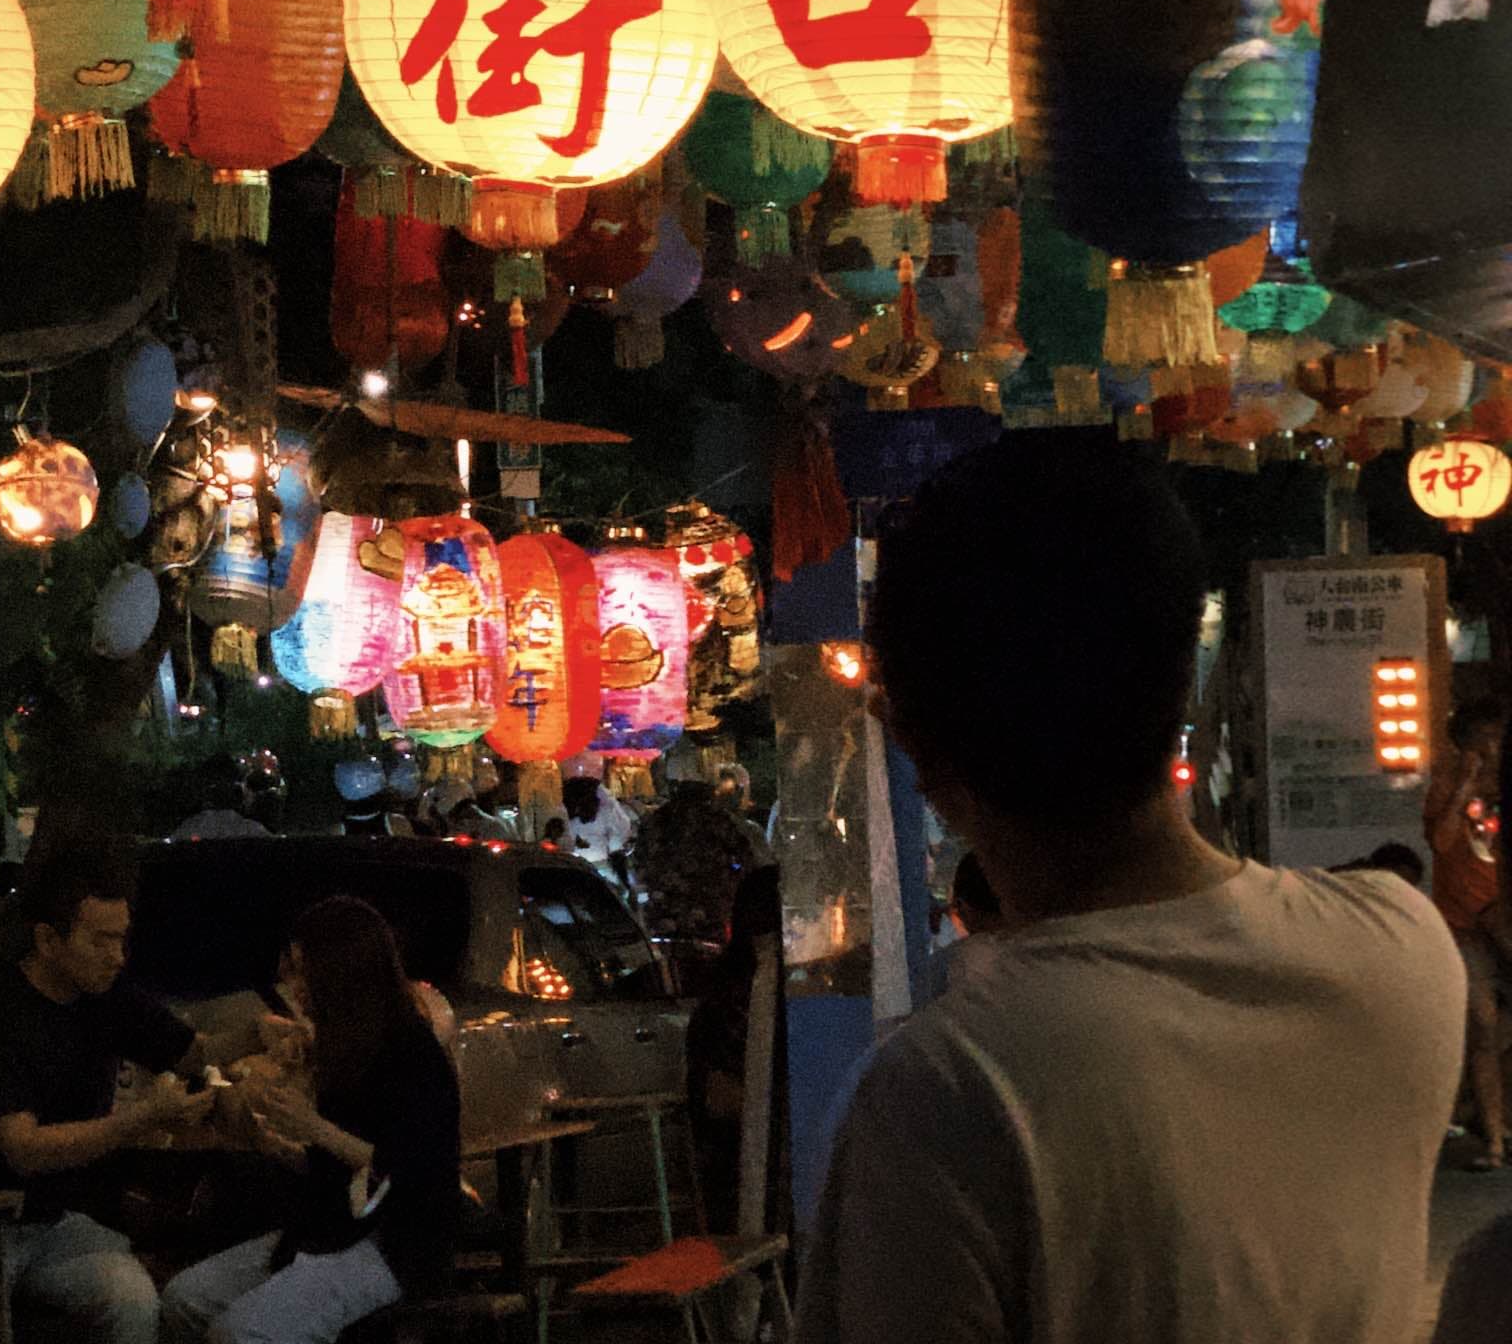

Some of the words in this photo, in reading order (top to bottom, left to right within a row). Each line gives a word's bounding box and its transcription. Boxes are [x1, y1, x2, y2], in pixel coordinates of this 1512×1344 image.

[1419, 451, 1483, 508] 神
[1305, 607, 1386, 632] 神農街
